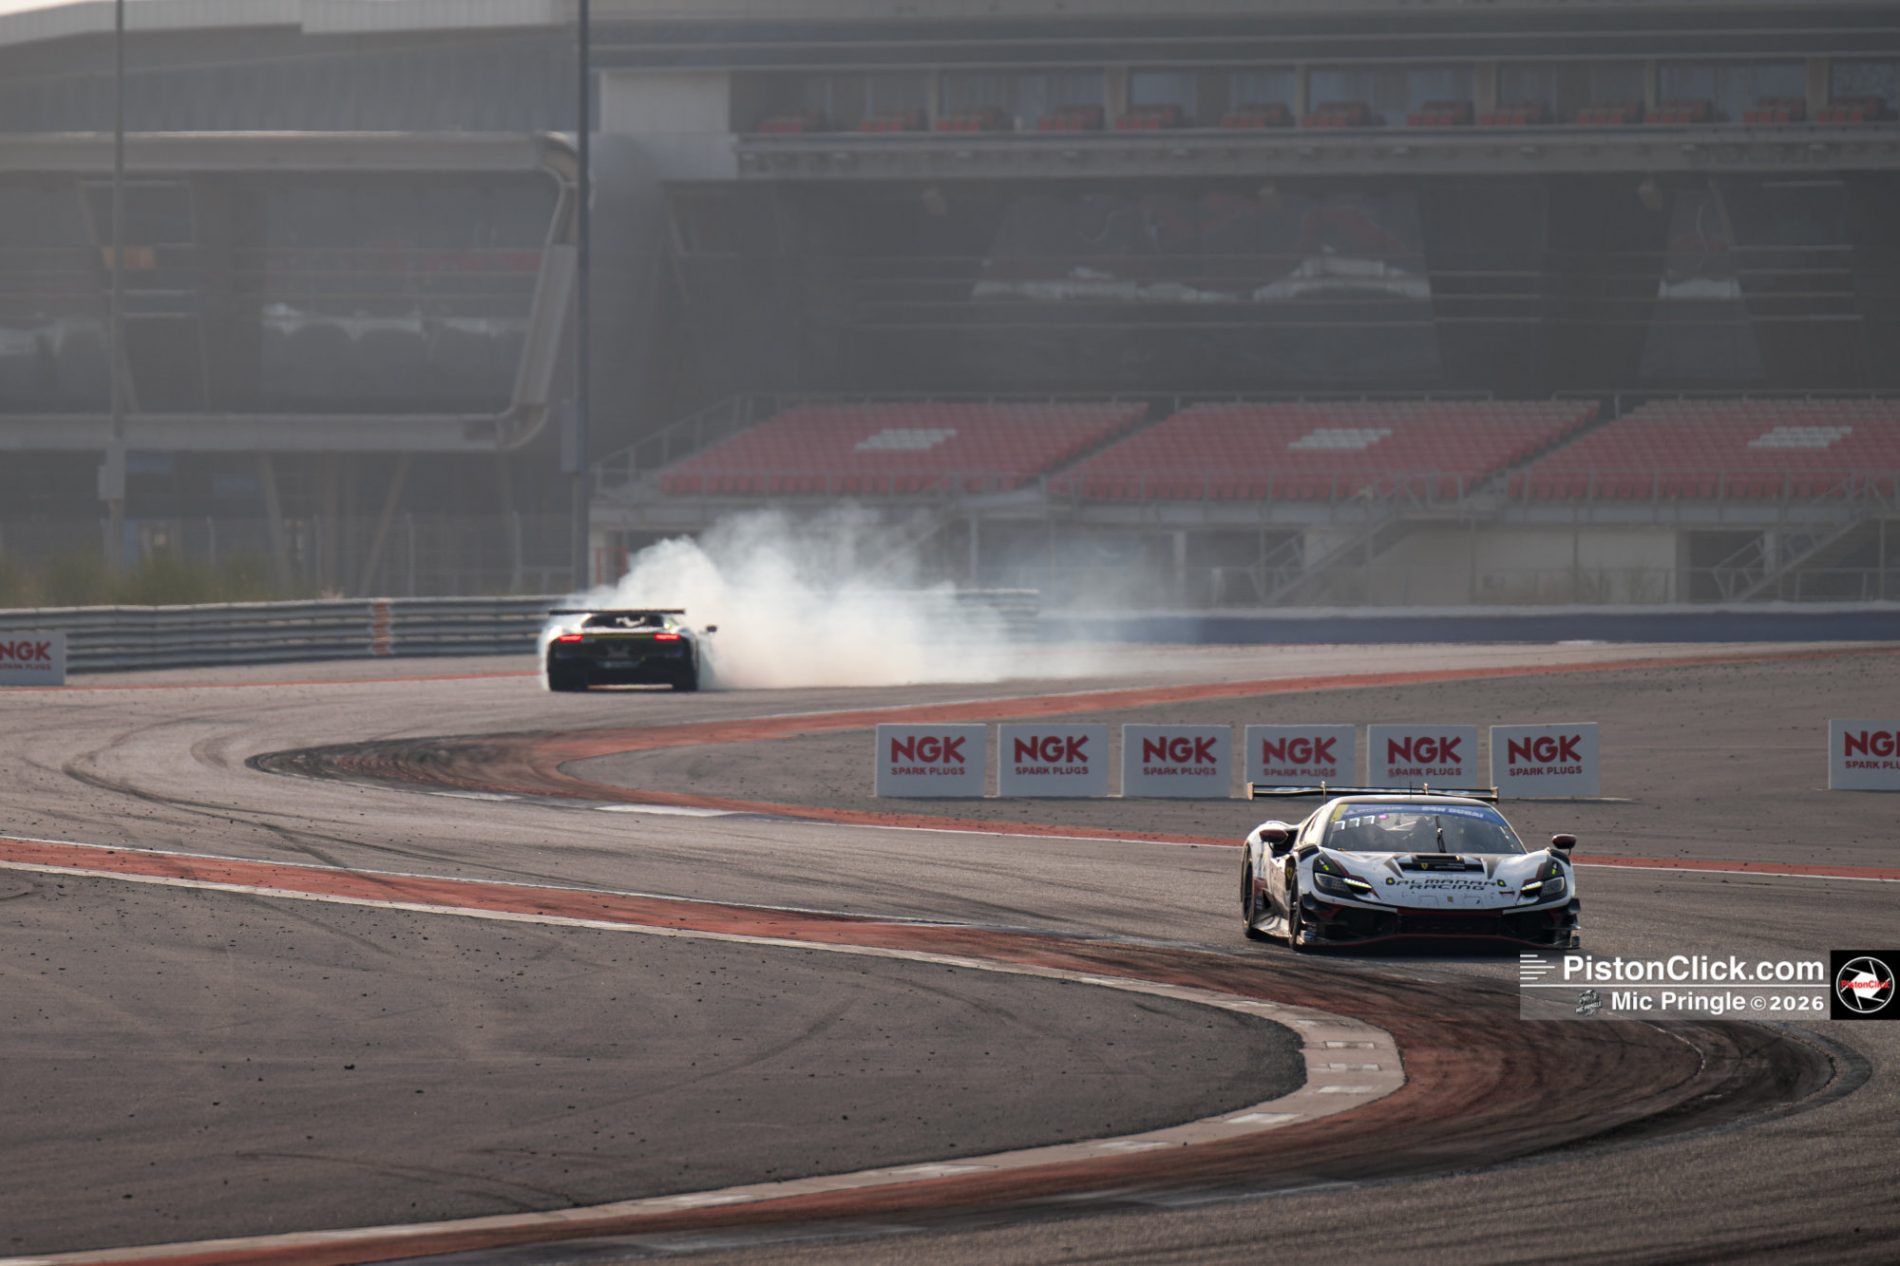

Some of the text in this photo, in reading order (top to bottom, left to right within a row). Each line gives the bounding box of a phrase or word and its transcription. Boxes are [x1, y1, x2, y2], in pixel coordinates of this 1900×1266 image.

[1015, 736, 1089, 763] NGK
[1143, 736, 1216, 763] NGK
[1508, 735, 1581, 763] NGK
[1844, 731, 1900, 757] NG
[891, 736, 966, 764] NGK
[1264, 736, 1336, 764] NGK
[1388, 737, 1462, 764] NGK
[1845, 760, 1880, 769] SPARK
[890, 766, 965, 775] SPARK PLUGS
[1015, 766, 1089, 775] SPARK PLUGS
[1143, 766, 1216, 775] SPARK PLUGS
[1263, 767, 1336, 776] SPARK PLUGS
[1387, 767, 1462, 776] SPARK PLUGS
[1508, 765, 1582, 776] SPARK PLUGS
[1408, 883, 1486, 891] RACING
